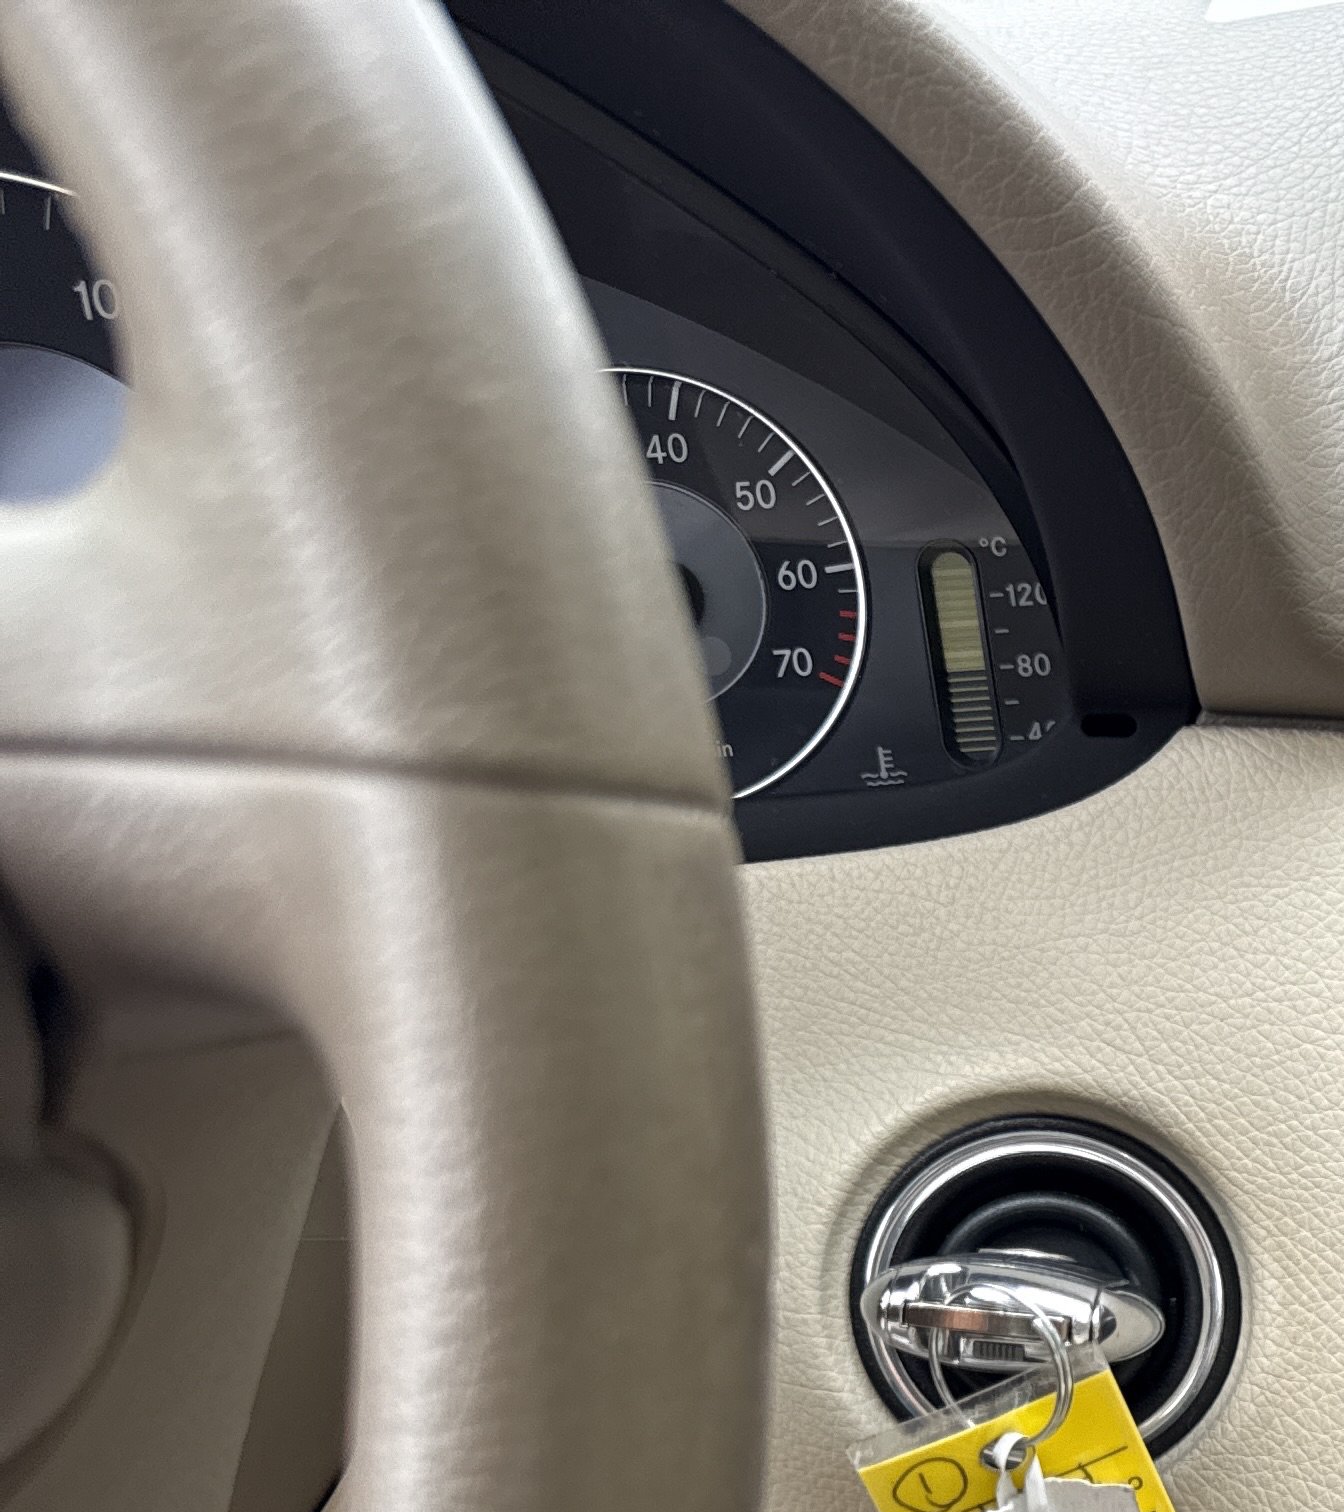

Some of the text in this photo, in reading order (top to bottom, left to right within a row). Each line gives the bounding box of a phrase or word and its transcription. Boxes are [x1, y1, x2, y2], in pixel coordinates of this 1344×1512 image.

[72, 279, 120, 320] 10
[645, 432, 688, 464] 40
[735, 480, 776, 511] 50
[777, 558, 817, 591] 60
[772, 647, 813, 678] 70
[1016, 653, 1051, 678] 80
[1029, 720, 1056, 741] 4
